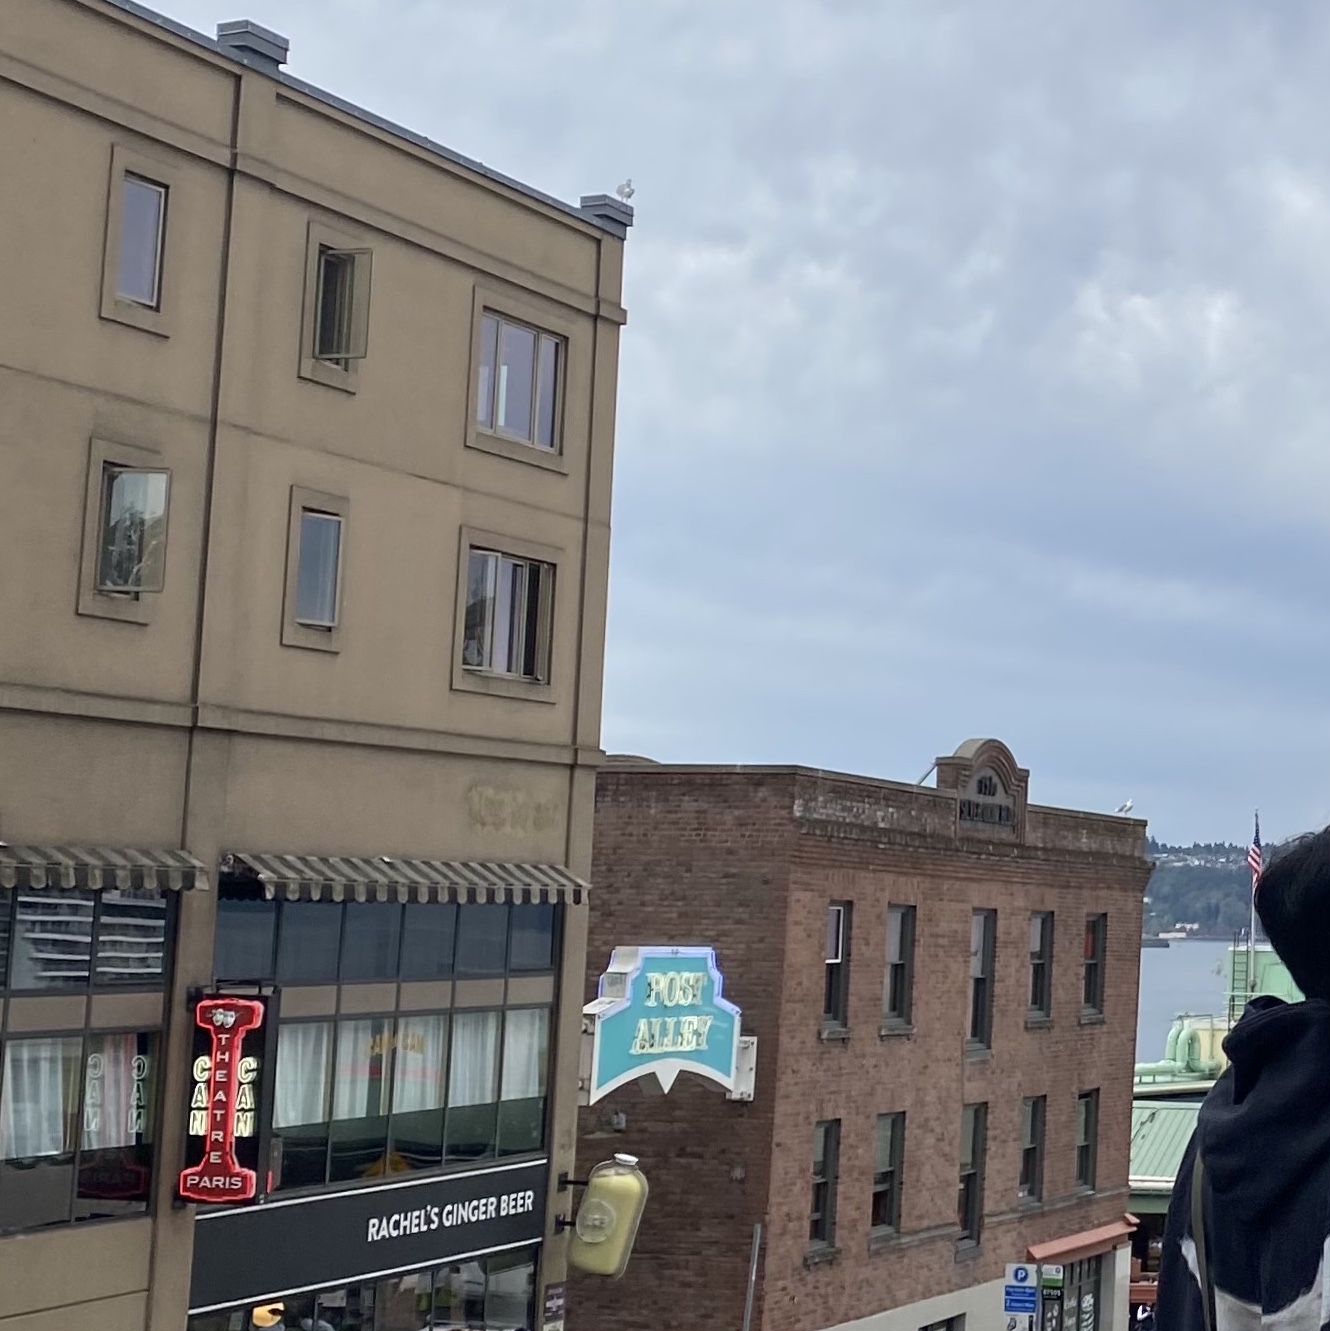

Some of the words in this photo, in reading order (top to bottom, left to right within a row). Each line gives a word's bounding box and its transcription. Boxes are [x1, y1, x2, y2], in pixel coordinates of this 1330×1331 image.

[645, 971, 708, 1007] POST
[629, 1015, 714, 1055] ALLEY
[189, 1056, 211, 1135] CAN
[208, 1033, 230, 1164] THEATRE
[233, 1056, 258, 1137] CAN
[186, 1174, 243, 1190] PARIS
[367, 1205, 440, 1242] RACHEL'S
[442, 1197, 498, 1227] GINGER
[500, 1190, 535, 1217] BEER
